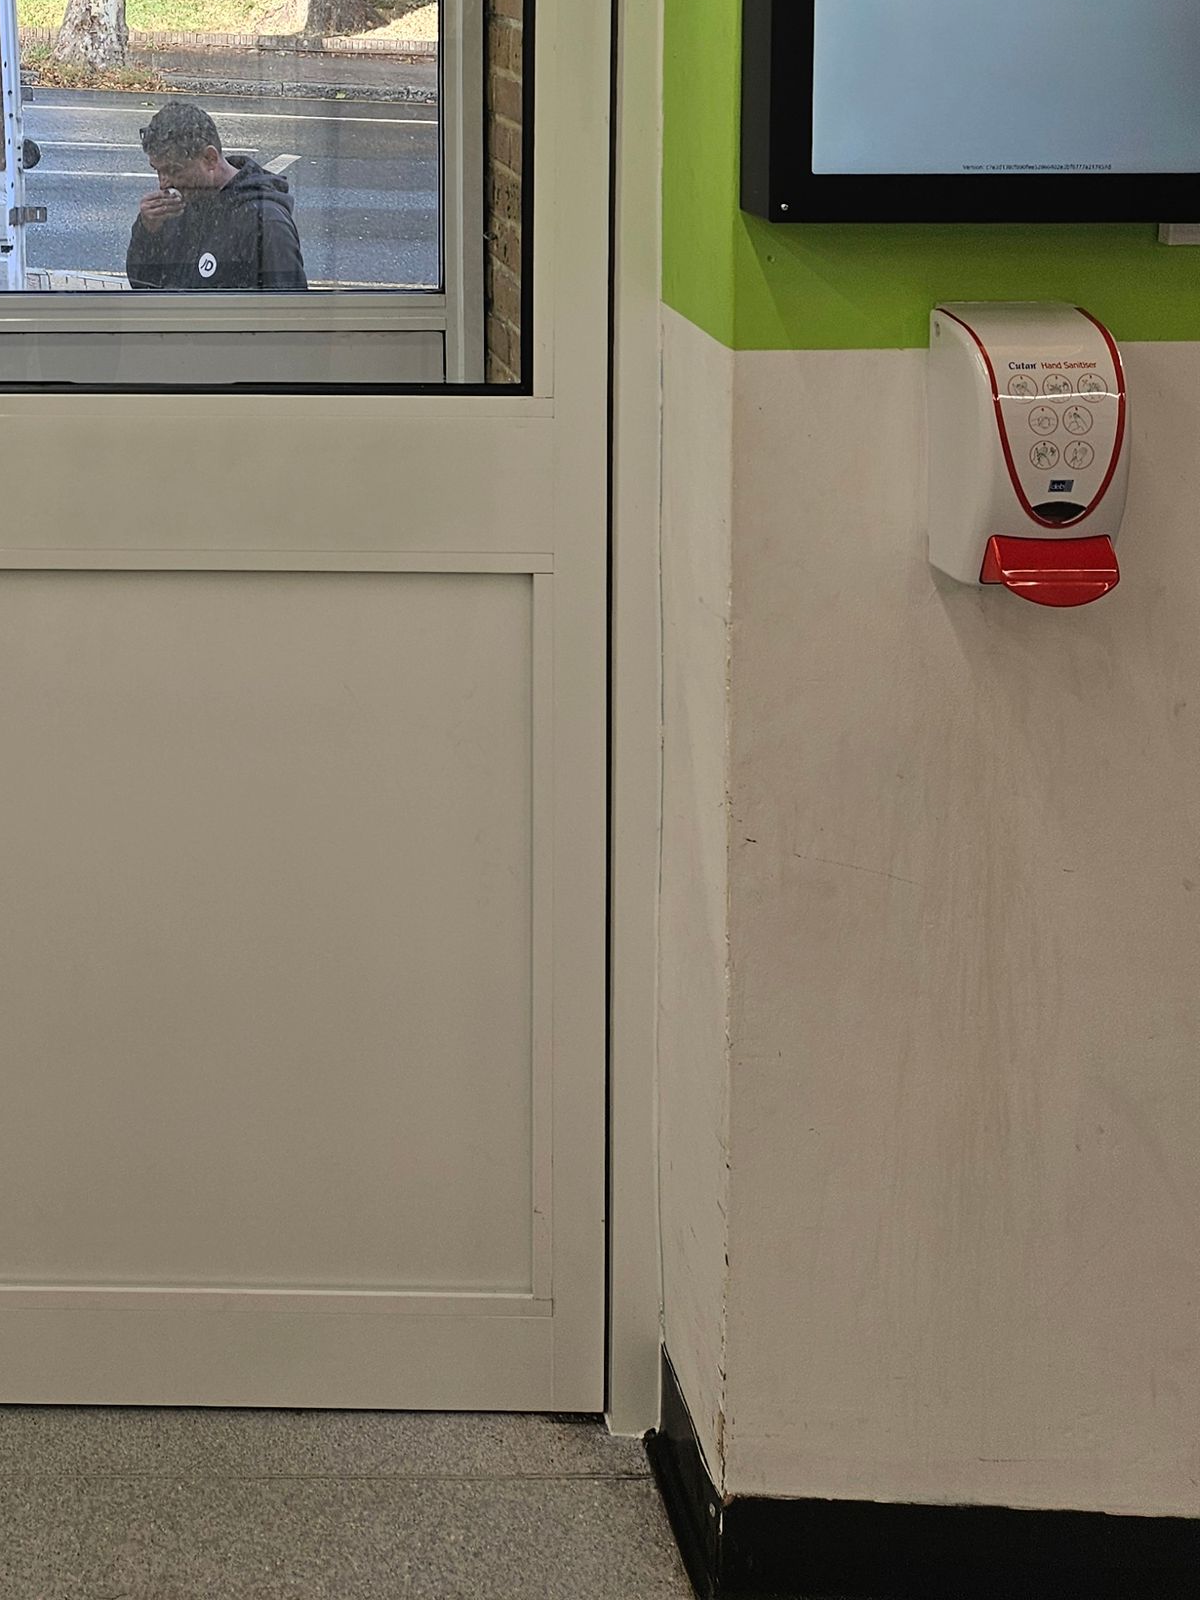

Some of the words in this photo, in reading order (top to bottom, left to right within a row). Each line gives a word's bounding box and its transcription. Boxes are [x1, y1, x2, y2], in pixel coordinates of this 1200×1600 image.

[1008, 361, 1036, 370] Cutan
[1041, 361, 1062, 369] Hand
[1064, 360, 1097, 369] Sanitiser
